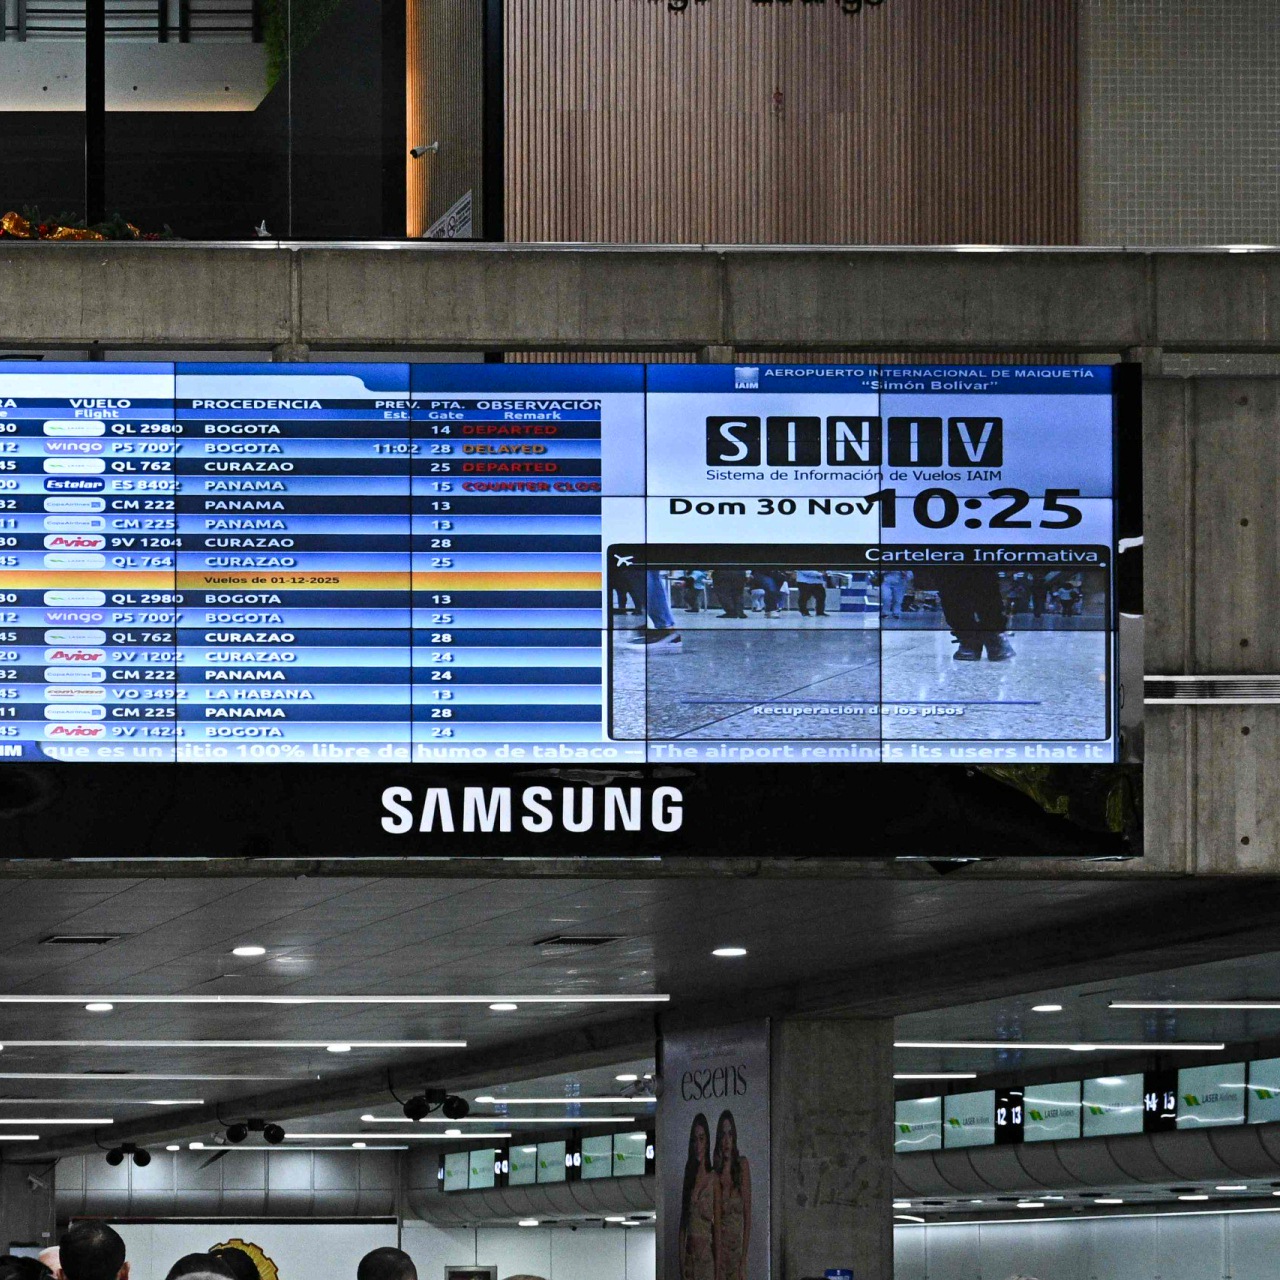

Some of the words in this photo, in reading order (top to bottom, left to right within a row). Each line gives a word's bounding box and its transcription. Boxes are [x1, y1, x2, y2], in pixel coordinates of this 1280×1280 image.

[765, 369, 864, 377] AEROPUERTO
[869, 369, 987, 378] INTERNACIONAL
[991, 369, 1011, 378] DE
[1015, 368, 1094, 378] MAIQUETÍA
[69, 399, 131, 409] VUELO
[192, 400, 323, 409] PROCEDENCIA
[374, 400, 420, 409] PREV.
[431, 401, 465, 410] PTA.
[74, 409, 119, 420] Flight
[383, 410, 412, 419] Est.
[428, 411, 464, 420] Gate
[504, 411, 561, 420] Remark
[111, 424, 137, 434] QL
[140, 424, 183, 433] 2980
[204, 424, 281, 434] BOGOTA
[431, 425, 451, 435] 14
[462, 425, 558, 435] DEPARTED
[46, 442, 103, 453] wingo
[139, 443, 181, 452] 7007
[204, 443, 282, 453] BOGOTA
[372, 444, 420, 454] 11:02
[431, 444, 452, 454] 28
[462, 444, 546, 454] DELAYED
[719, 421, 994, 463] SINIV
[111, 461, 137, 472] QL
[141, 461, 172, 471] 762
[204, 461, 295, 472] CURAZAO
[431, 463, 451, 472] 25
[462, 463, 558, 473] DEPARTED
[706, 470, 765, 481] Sistema
[769, 469, 789, 481] de
[794, 469, 884, 481] Información
[889, 470, 908, 481] de
[912, 470, 962, 481] Vuelos
[966, 470, 1002, 481] IAIM
[46, 480, 103, 490] Estelar
[111, 480, 138, 490] ES
[139, 480, 181, 490] 8402
[205, 481, 286, 491] PANAMA
[431, 482, 452, 491] 15
[462, 482, 550, 492] COUNTER
[669, 499, 746, 515] Dom
[757, 498, 797, 515] 30
[808, 498, 874, 515] Nov
[864, 487, 1083, 529] 10:25
[864, 548, 965, 562] Cartelera
[973, 548, 1098, 562] Informativa
[204, 576, 248, 584] Vuelos
[251, 576, 267, 584] de
[270, 576, 340, 584] 01-12-2025
[753, 704, 868, 718] Recuperación
[870, 705, 890, 716] de
[893, 705, 918, 716] los
[921, 705, 964, 718] pisos
[381, 786, 684, 834] SAMSUNG
[1162, 1091, 1176, 1111] 15
[996, 1107, 1007, 1126] 12
[1011, 1105, 1022, 1125] 13
